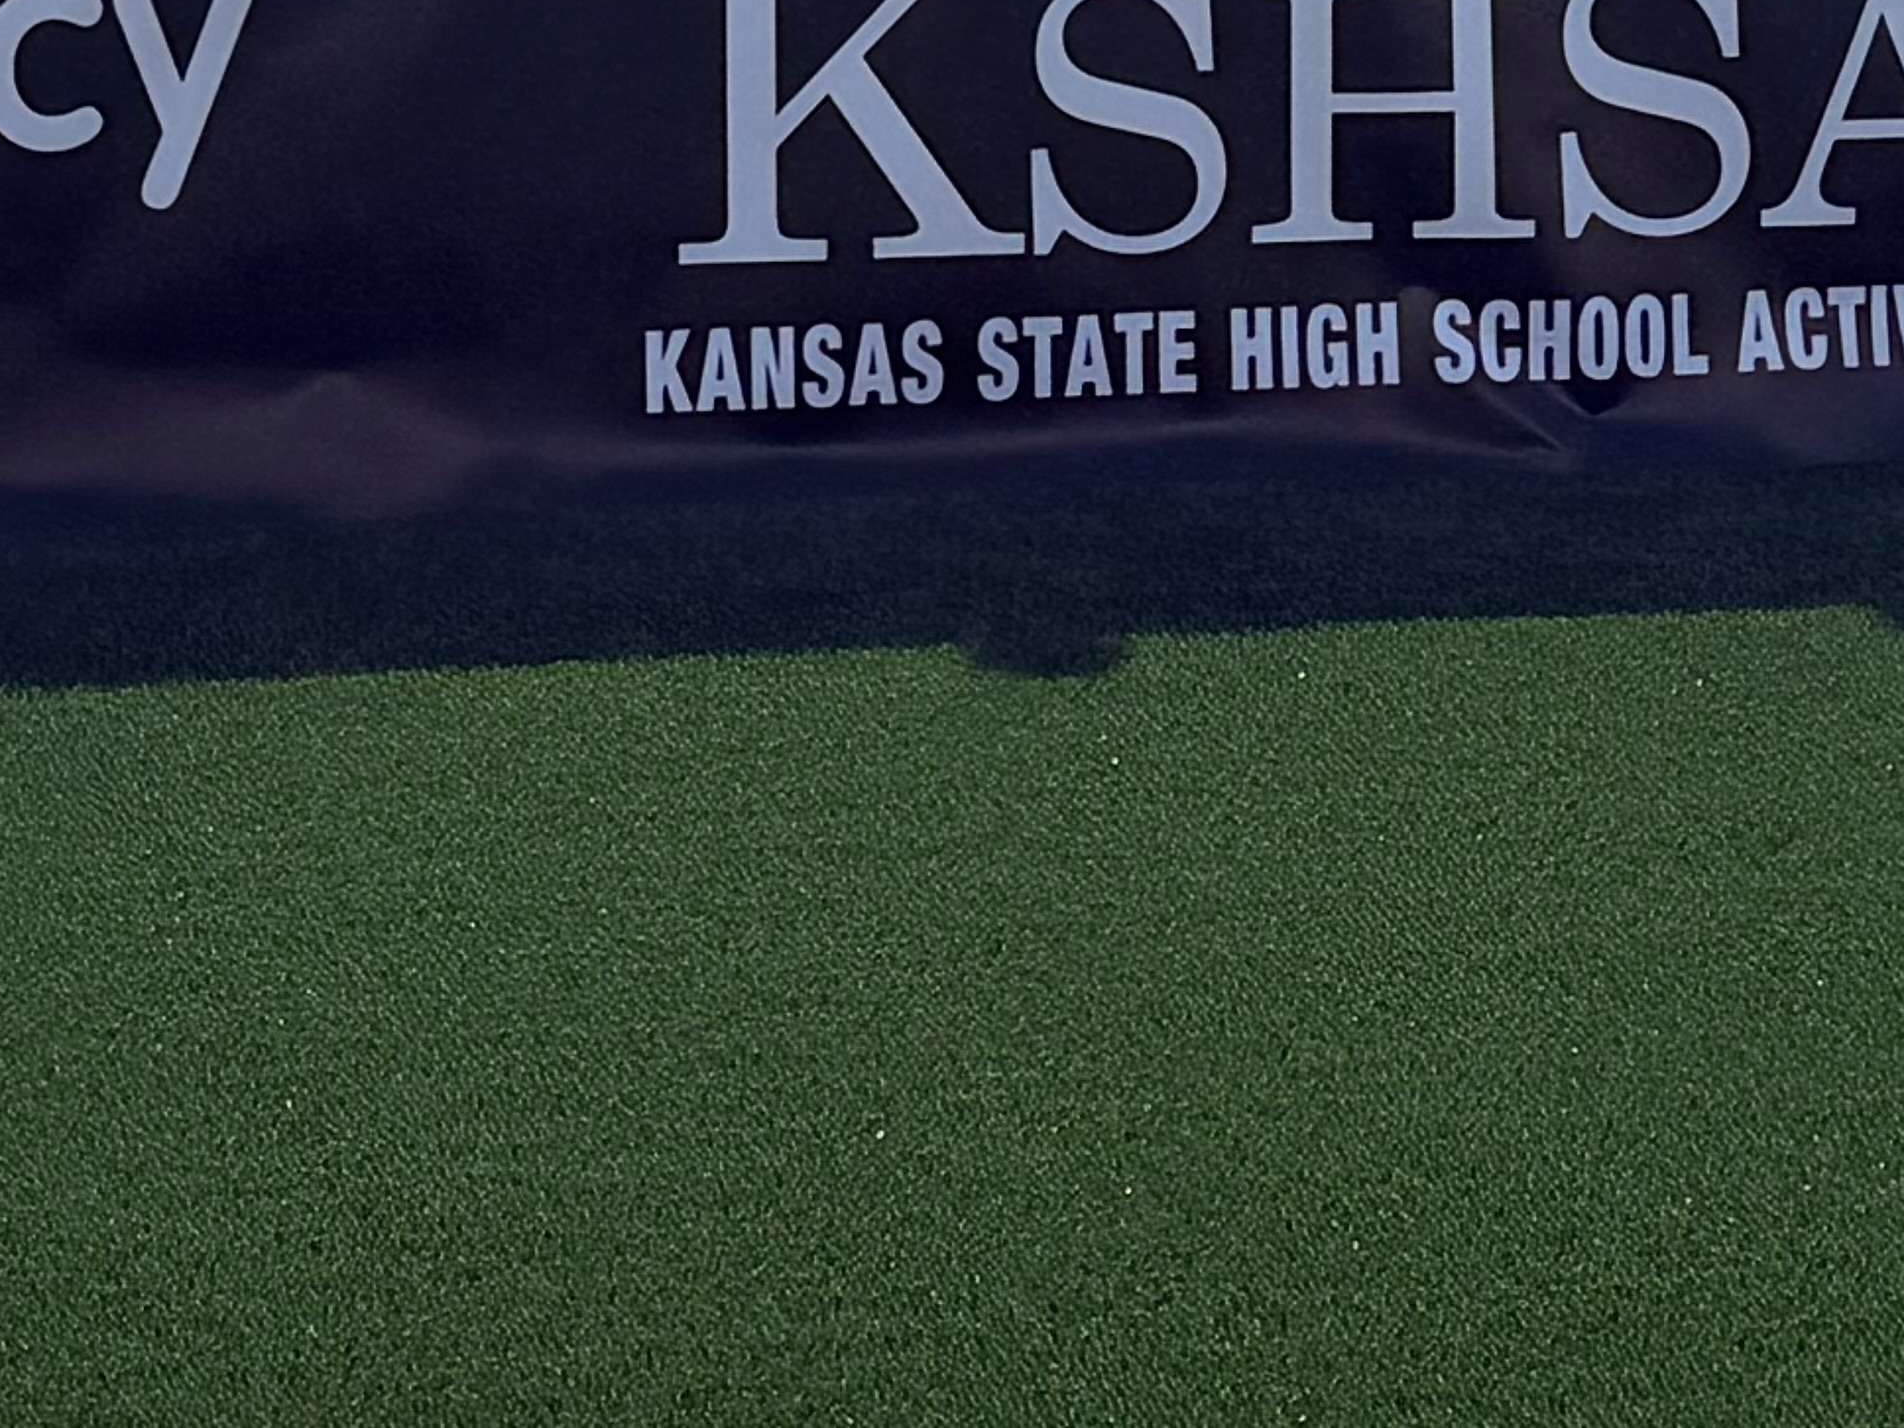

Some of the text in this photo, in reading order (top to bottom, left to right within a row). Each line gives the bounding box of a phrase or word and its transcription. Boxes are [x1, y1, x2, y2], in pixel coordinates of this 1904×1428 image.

[645, 320, 943, 413] KANSAS
[978, 310, 1197, 401] STATE
[1230, 302, 1400, 390] HIGH
[1433, 293, 1710, 384] SCHOOL
